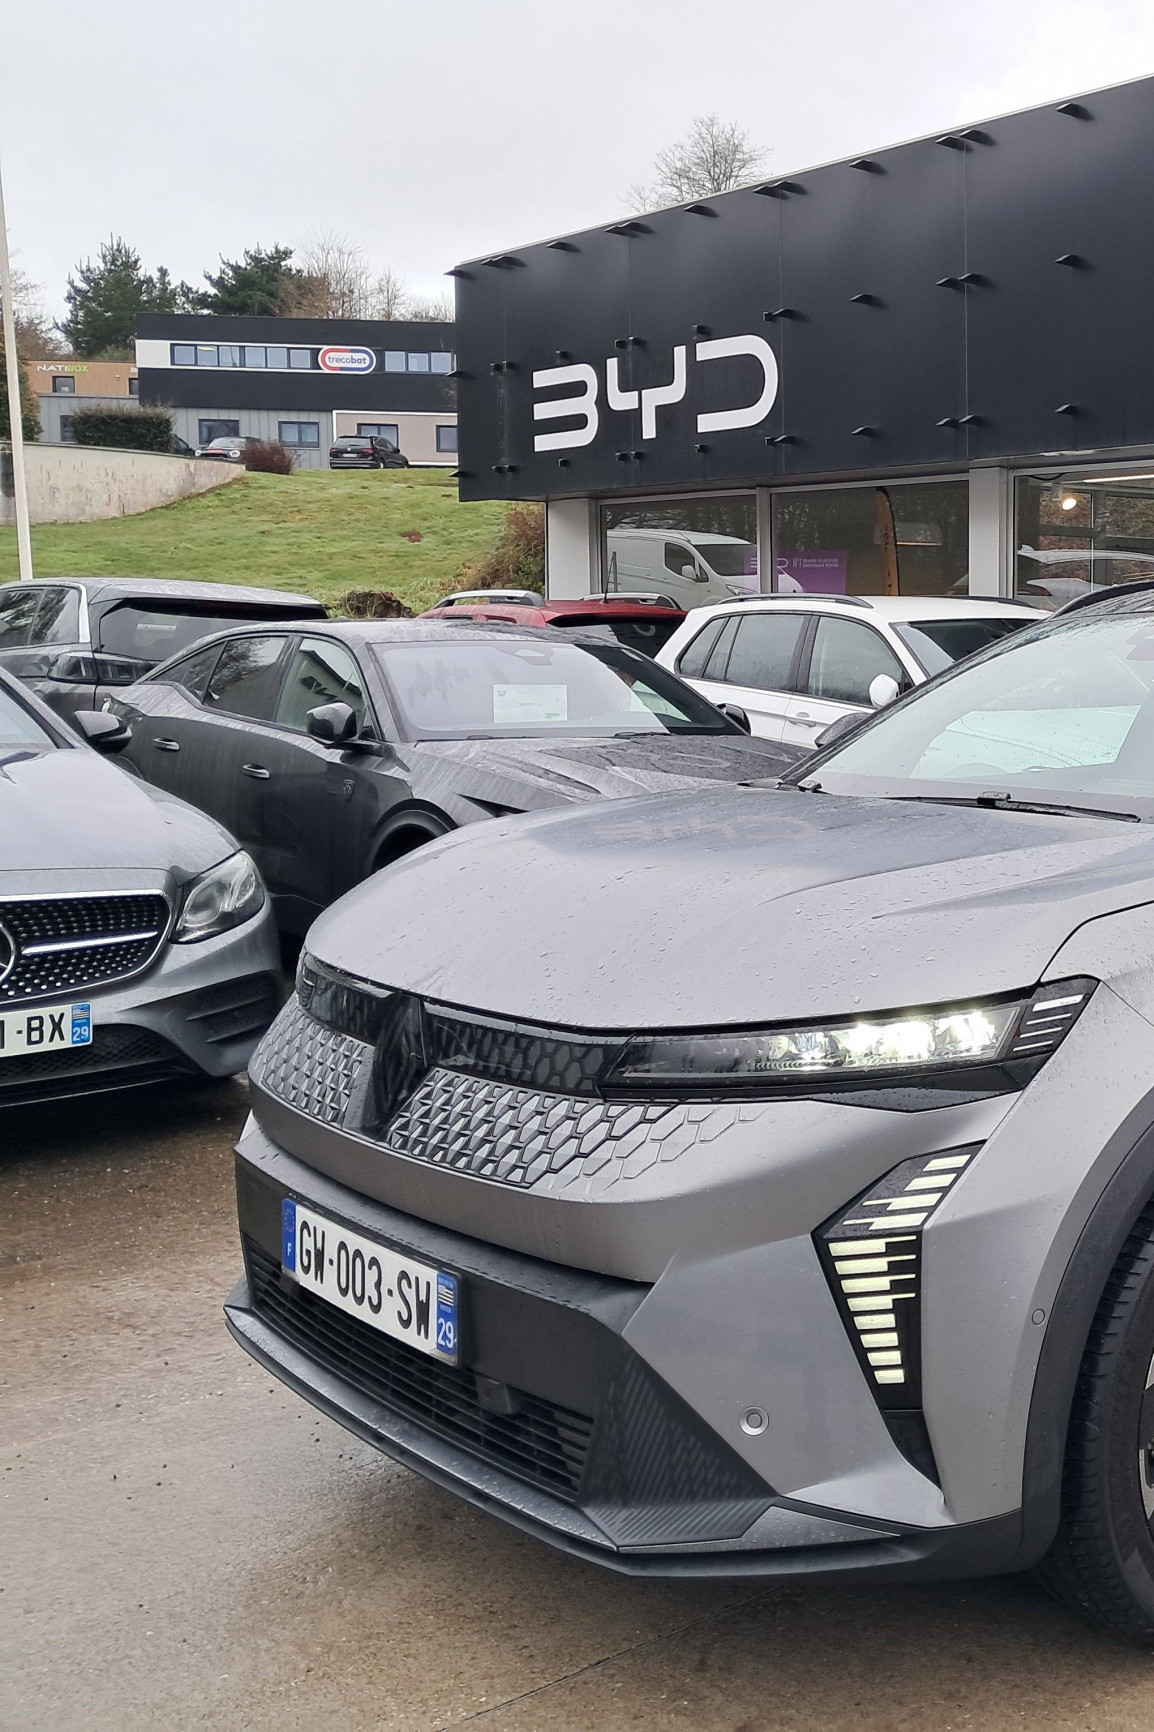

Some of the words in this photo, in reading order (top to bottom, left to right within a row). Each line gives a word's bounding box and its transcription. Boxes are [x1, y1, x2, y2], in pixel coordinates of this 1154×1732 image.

[327, 355, 367, 364] trecobat
[36, 364, 88, 372] NATIBOX
[532, 334, 779, 452] BYD
[72, 1026, 89, 1041] 29
[287, 1242, 292, 1256] F
[300, 1220, 431, 1340] GW-003-SW
[437, 1318, 455, 1348] 29
